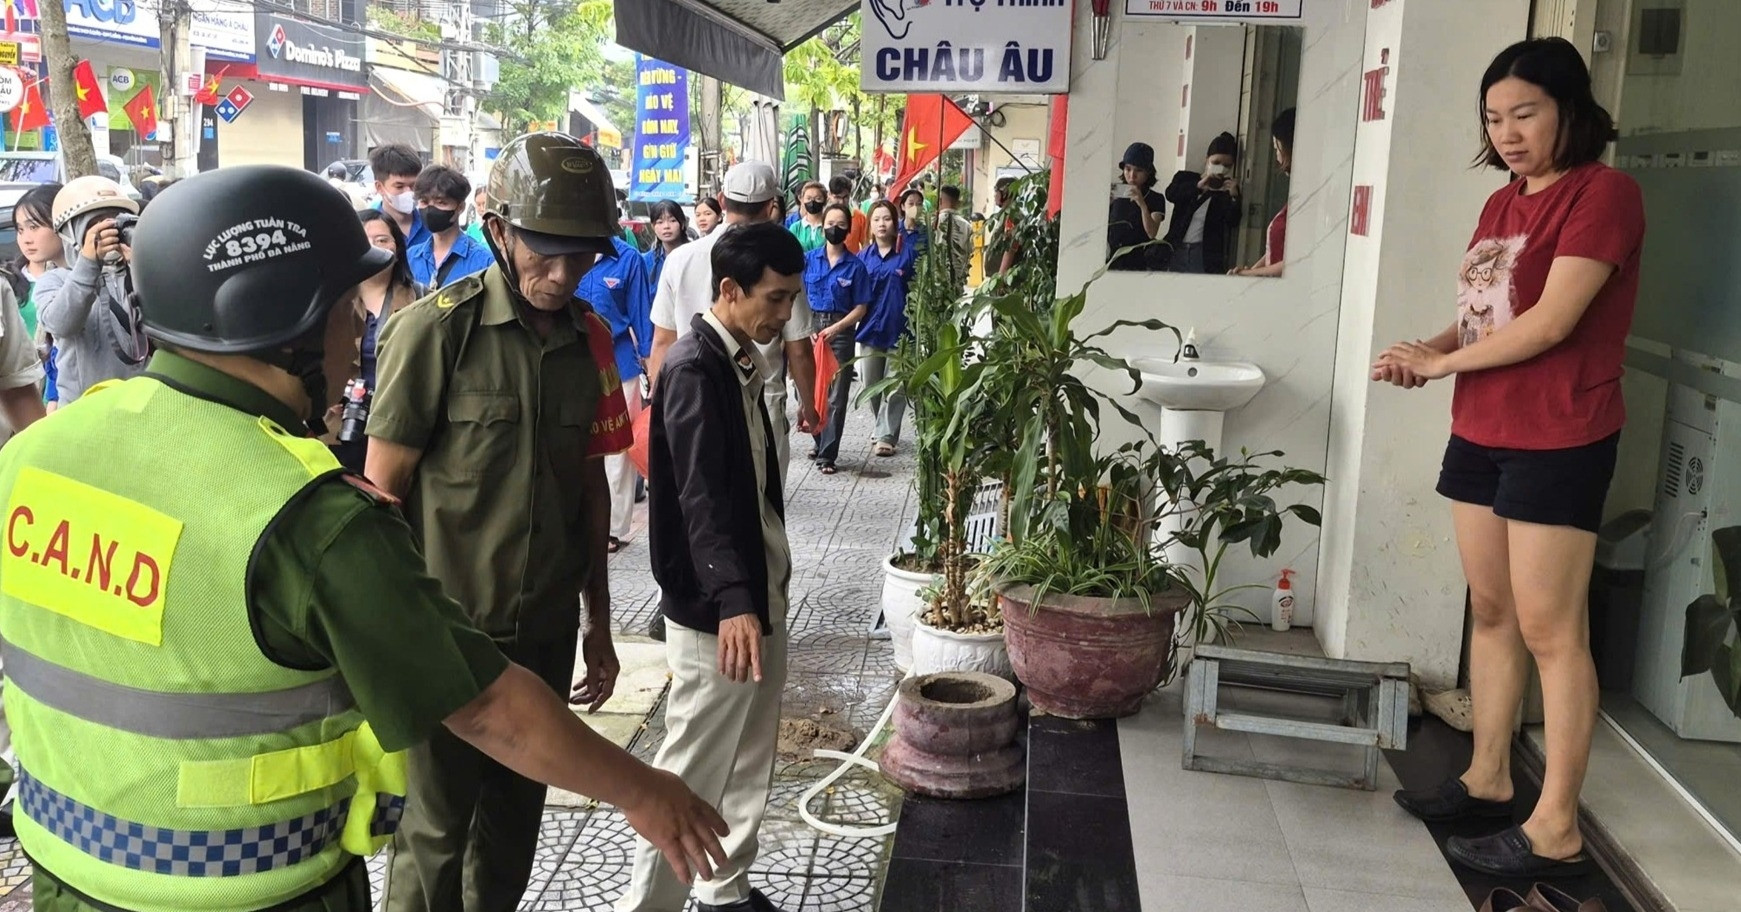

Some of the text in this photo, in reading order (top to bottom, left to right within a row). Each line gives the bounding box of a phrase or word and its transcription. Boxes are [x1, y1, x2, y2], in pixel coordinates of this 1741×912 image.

[1166, 1, 1172, 11] 7
[1201, 1, 1217, 12] 9h
[1255, 2, 1278, 13] 19h
[285, 40, 361, 71] Domino's Pizza
[876, 41, 1053, 83] CHÂU ÂU
[112, 75, 129, 83] ACB
[204, 118, 213, 126] 294
[286, 221, 307, 238] TRA
[225, 229, 287, 257] 8394
[8, 505, 160, 607] C.A.N.D
